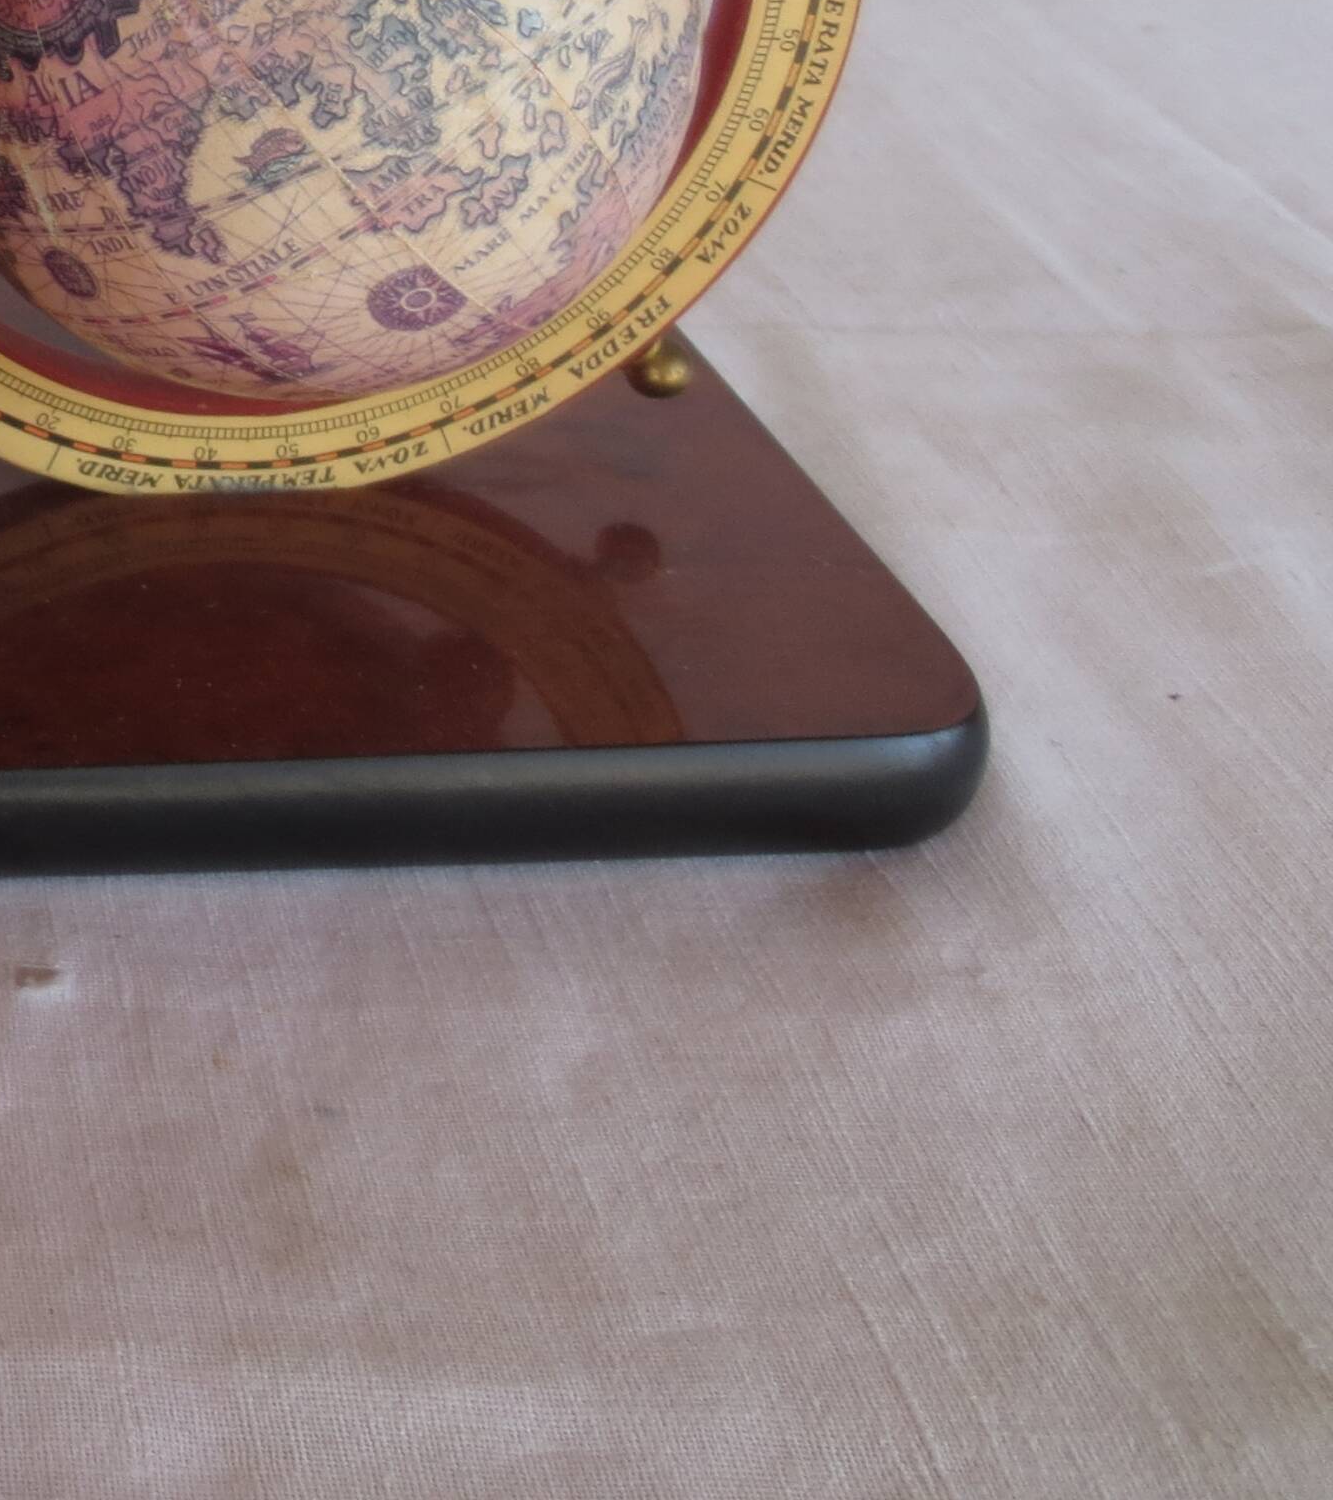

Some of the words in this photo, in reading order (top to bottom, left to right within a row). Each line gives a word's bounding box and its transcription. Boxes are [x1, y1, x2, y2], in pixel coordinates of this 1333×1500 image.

[783, 28, 801, 52] 50
[749, 107, 771, 132] 60
[706, 180, 729, 204] 70
[696, 201, 753, 266] ZONA
[568, 295, 672, 381] FREDDA
[353, 440, 430, 476] ZONA
